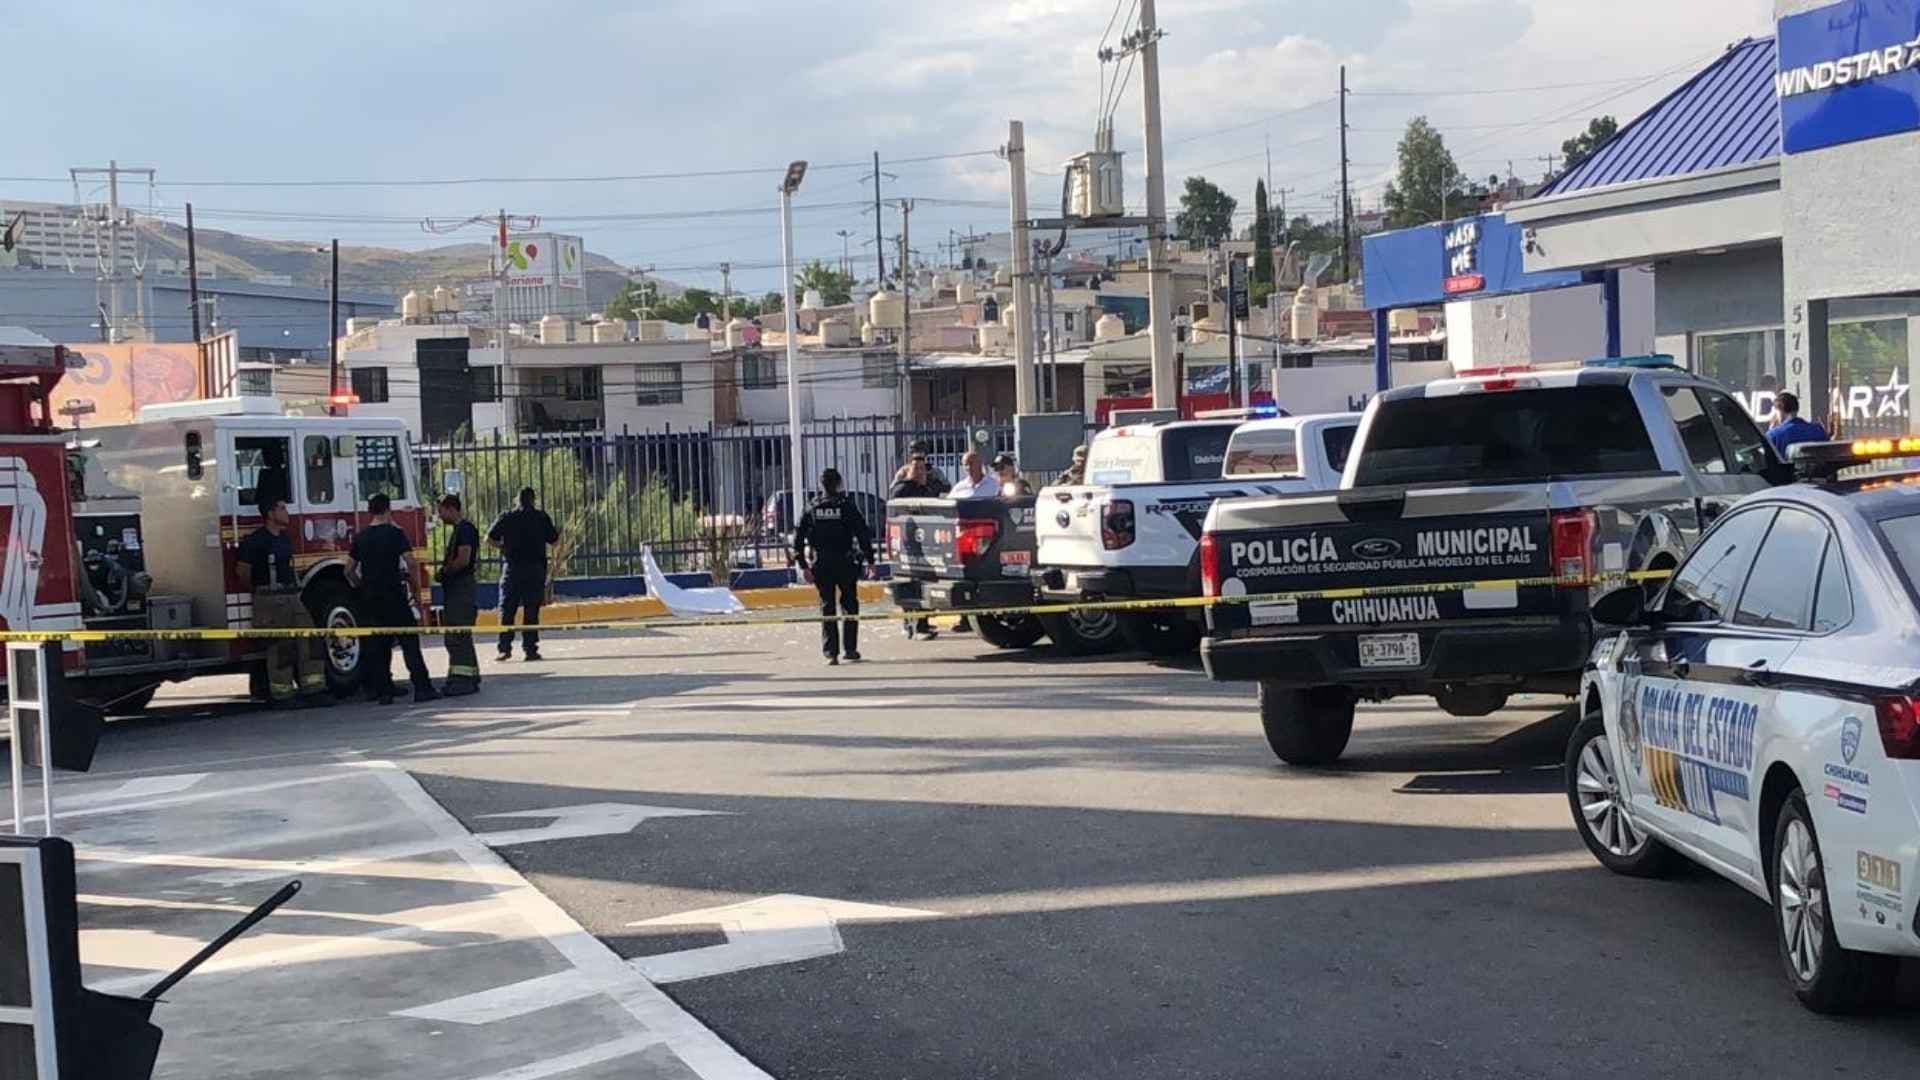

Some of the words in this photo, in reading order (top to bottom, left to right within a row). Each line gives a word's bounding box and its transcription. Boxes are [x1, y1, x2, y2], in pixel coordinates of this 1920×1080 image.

[1775, 44, 1902, 97] WINDSTAR
[505, 275, 544, 286] oriana
[1231, 532, 1338, 566] POLICÍA
[1417, 526, 1537, 556] MUNICIPAL
[1308, 562, 1321, 574] DE
[1324, 561, 1380, 573] SEGURIDAD
[1428, 556, 1472, 568] MODELO
[1475, 556, 1489, 567] EN
[1492, 555, 1504, 566] EL
[1506, 552, 1531, 564] PAÍS
[1332, 596, 1440, 624] CHIHUAHUA
[1683, 692, 1705, 757] DEL
[1706, 696, 1758, 771] ESTADO
[1860, 855, 1897, 890] 911
